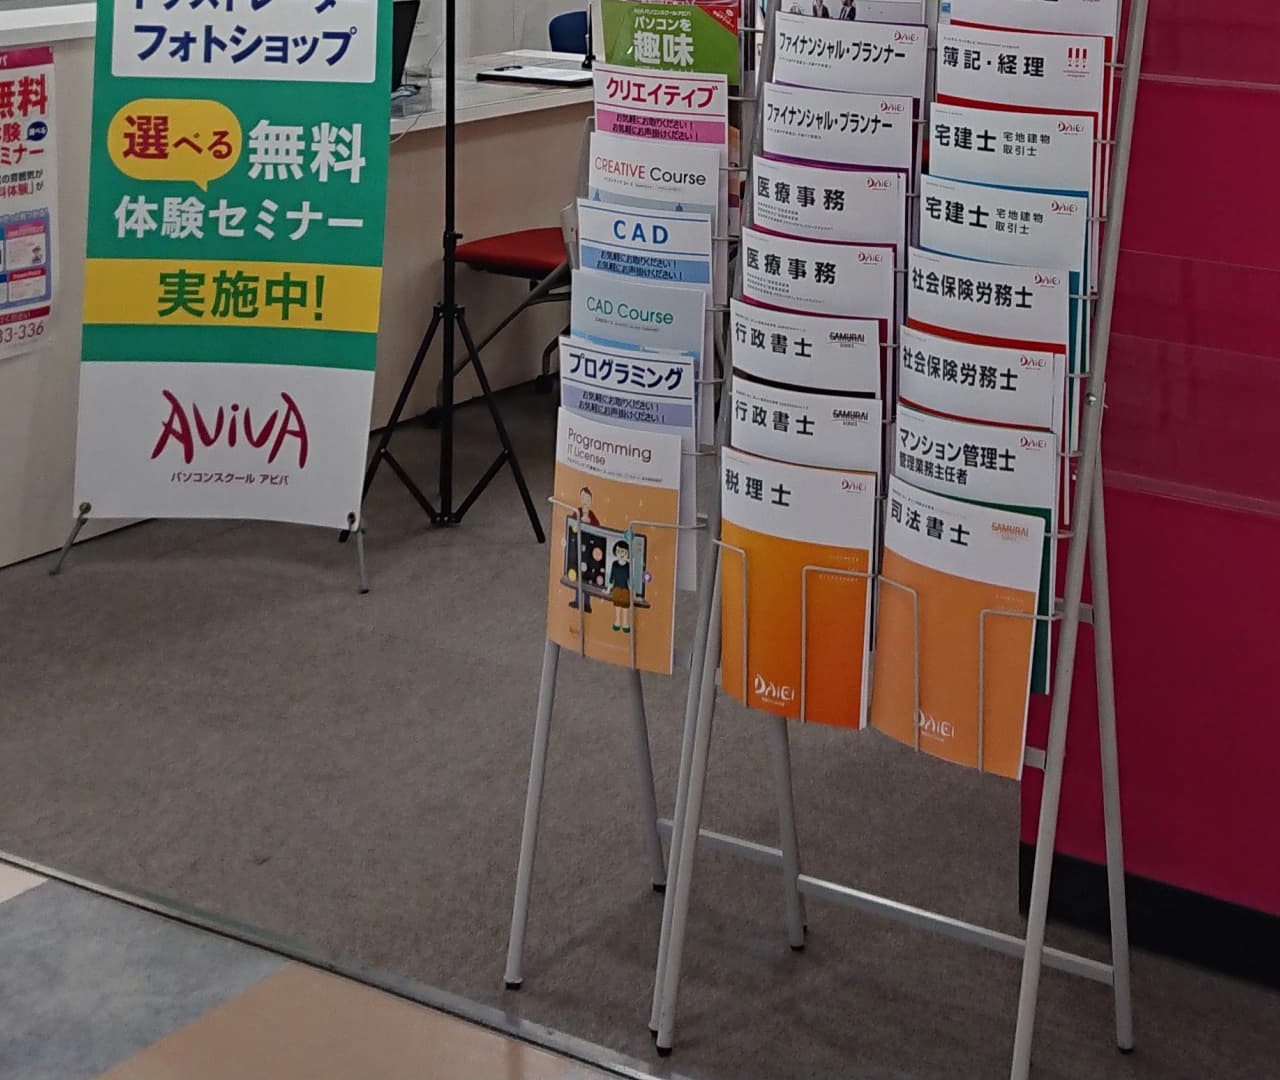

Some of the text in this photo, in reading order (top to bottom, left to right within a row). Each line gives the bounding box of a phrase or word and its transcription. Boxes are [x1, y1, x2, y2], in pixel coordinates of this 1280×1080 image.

[635, 17, 691, 32] パソコンを
[134, 25, 357, 66] フォトショップ
[634, 31, 693, 67] 趣味
[779, 32, 906, 64] ファイナンシャル・プランナー
[943, 45, 1044, 78] 簿記・経理
[606, 77, 718, 108] クリエイティブ
[767, 103, 893, 134] ファイナンシャル・プランナー
[123, 115, 366, 183] 選べる 無料
[935, 124, 996, 153] 宅建士
[1002, 144, 1037, 157] 取引士
[1003, 131, 1051, 145] 宅地建物
[595, 156, 646, 179] CREATIVE
[650, 167, 706, 186] Course
[757, 176, 845, 211] 医療事務
[114, 195, 363, 241] 体験セミナー
[925, 196, 989, 229] 宅建士
[995, 220, 1030, 235] 取引士
[996, 208, 1043, 224] 宅地建物
[614, 220, 668, 245] CAD
[746, 247, 837, 285] 医療事務
[158, 269, 324, 321] 実施中!
[911, 267, 1033, 309] 社会保険労務士
[587, 296, 673, 324] CAD Course
[736, 321, 812, 358] 行政書士
[829, 332, 865, 342] SAMURAI
[570, 351, 683, 391] プログラミング
[902, 345, 1018, 391] 社会保険労務士
[736, 400, 815, 436] 行政書士
[833, 409, 868, 420] SAMURAI
[568, 427, 652, 463] Programming
[574, 446, 606, 466] License
[899, 428, 1016, 472] マンション管理士
[171, 472, 288, 486] パソコンスクール アビバ
[899, 452, 968, 486] 管理業務主任者
[725, 468, 791, 507] 税理士
[890, 499, 969, 547] 司法書士
[991, 522, 1029, 537] SAMURAI
